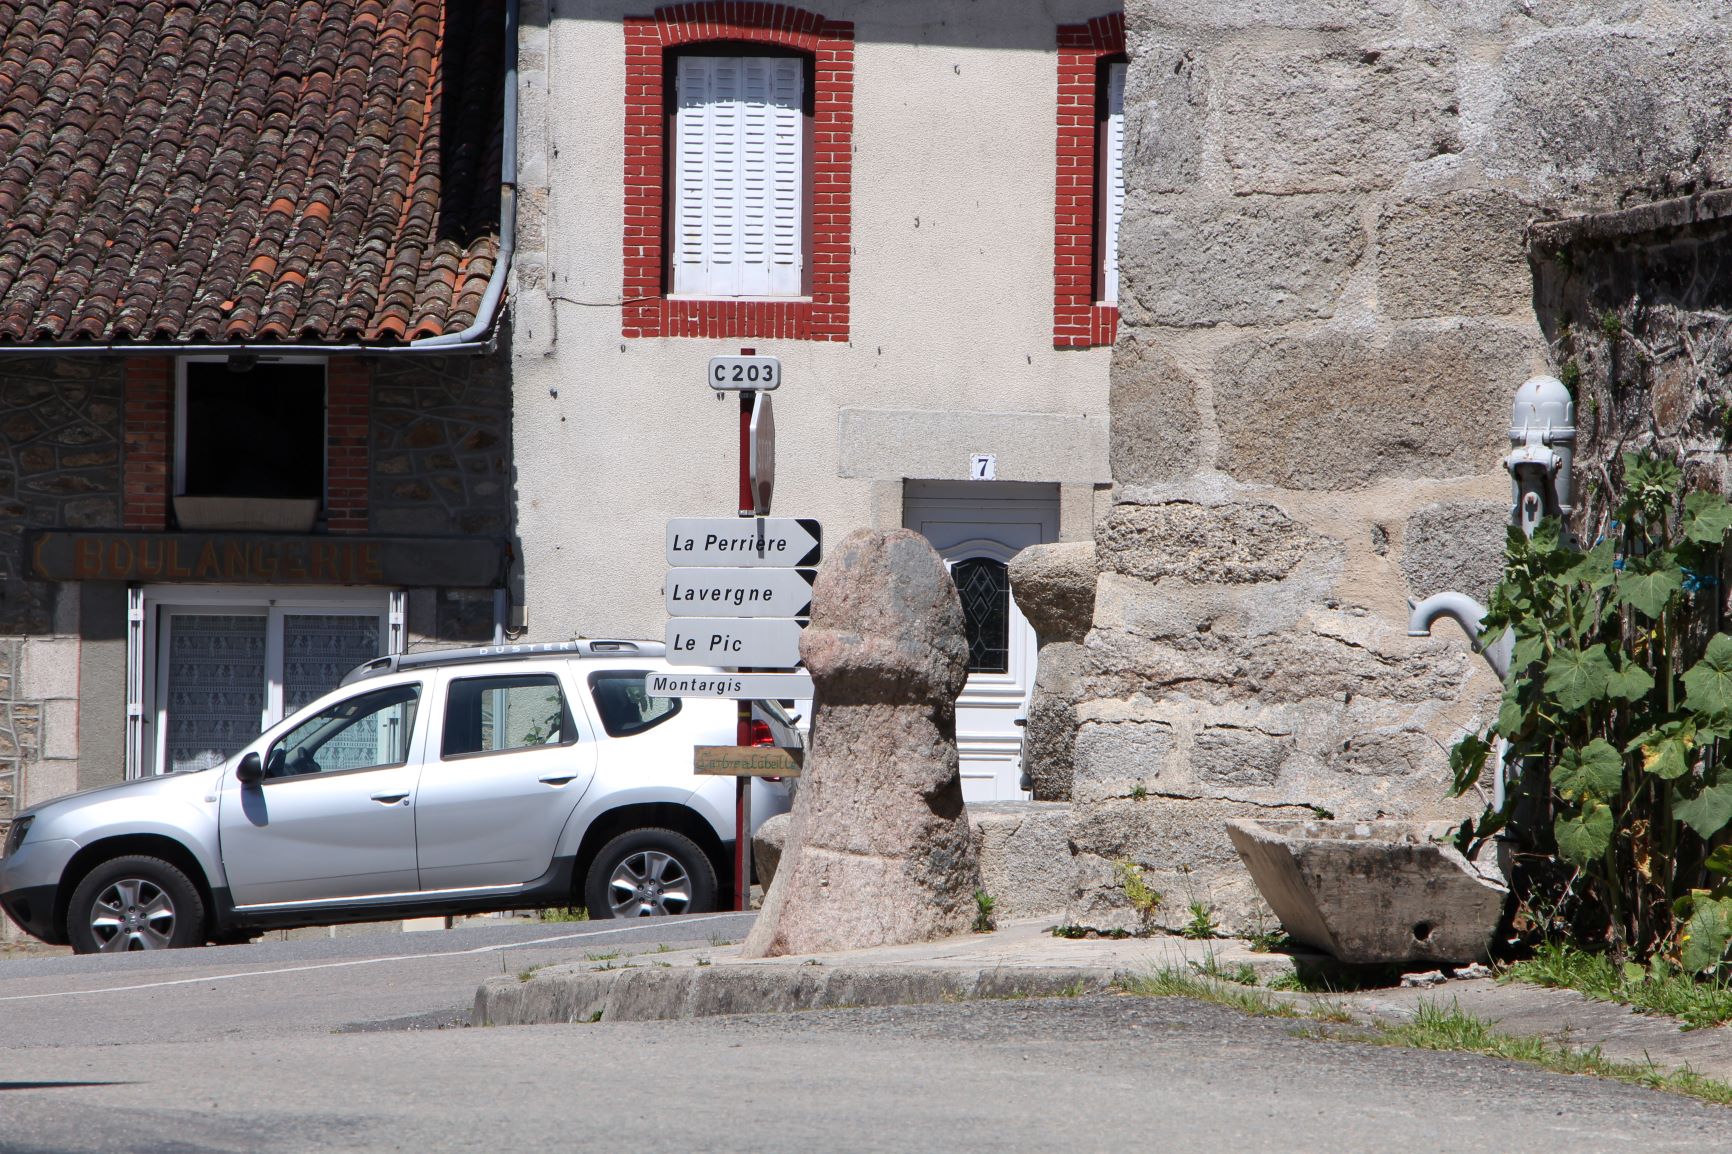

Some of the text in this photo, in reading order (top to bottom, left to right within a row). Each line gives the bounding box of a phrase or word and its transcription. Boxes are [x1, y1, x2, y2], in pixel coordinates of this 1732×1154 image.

[714, 364, 773, 382] C 203
[978, 458, 989, 477] 7
[673, 534, 787, 551] La Perrière
[73, 537, 385, 578] BOULANGERIE
[672, 584, 773, 606] Lavergne
[479, 643, 570, 655] DUSTER
[673, 634, 742, 651] Le Pic
[653, 677, 742, 695] Montargis
